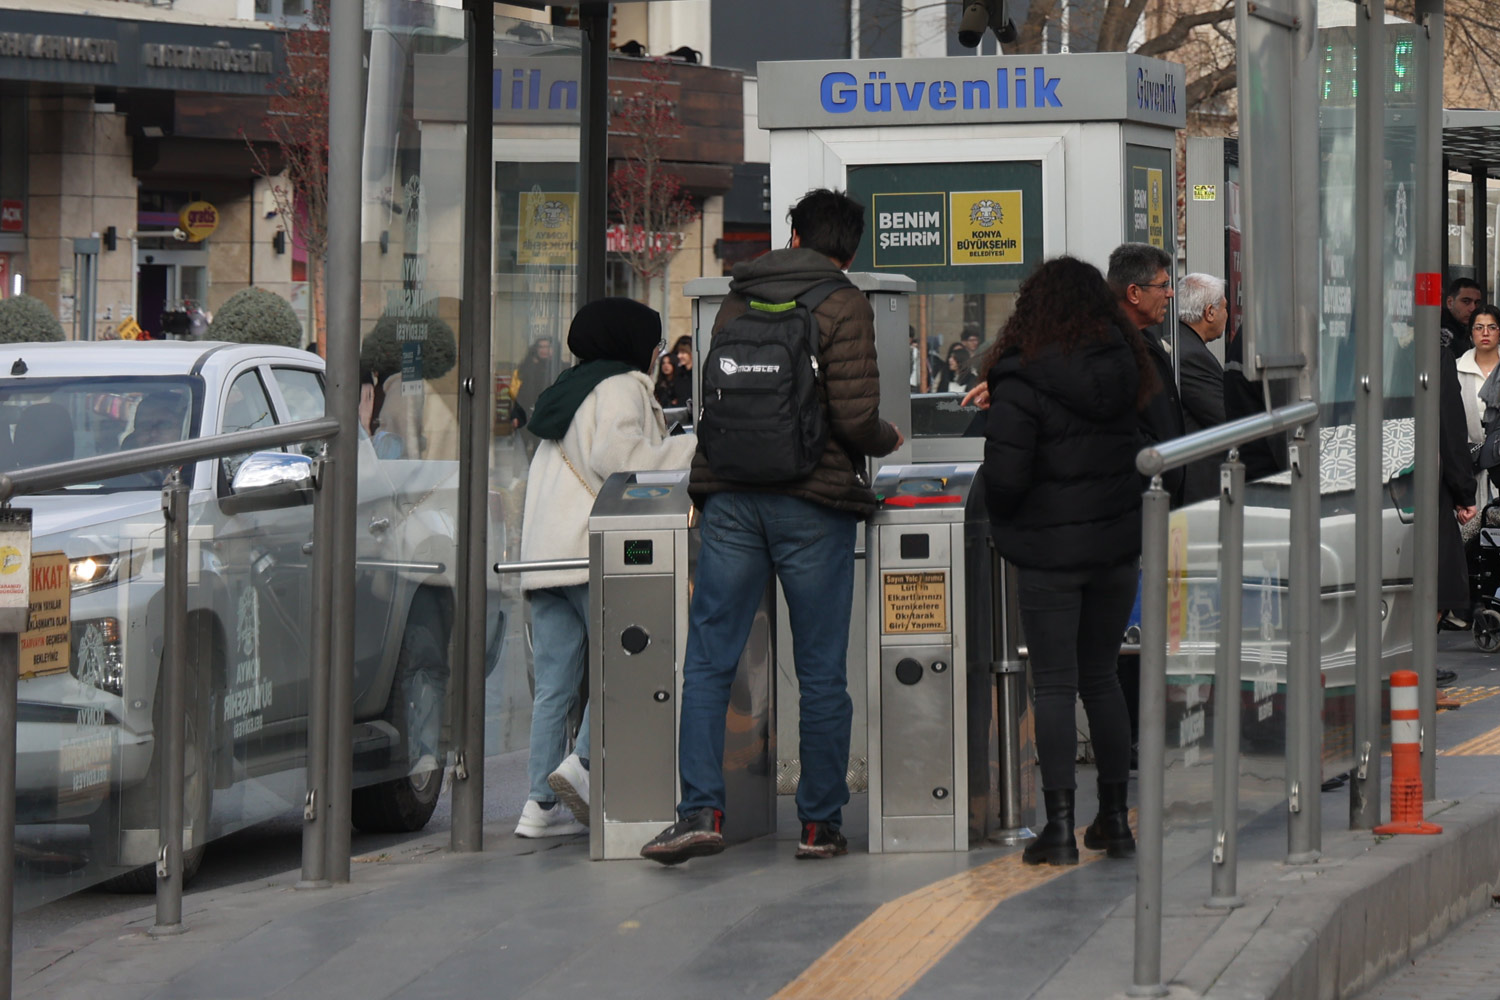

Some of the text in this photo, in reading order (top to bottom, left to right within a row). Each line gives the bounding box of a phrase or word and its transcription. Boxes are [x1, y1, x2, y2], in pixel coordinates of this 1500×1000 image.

[819, 67, 1063, 114] Güvenlik
[1136, 67, 1177, 115] Güvenlik
[188, 205, 216, 228] gratis
[879, 211, 940, 230] BENİM
[880, 231, 940, 249] ŞEHRİM
[957, 239, 1017, 251] BÜYÜKŞEHİR
[972, 231, 1002, 239] KONYA
[31, 563, 63, 592] İKKAT
